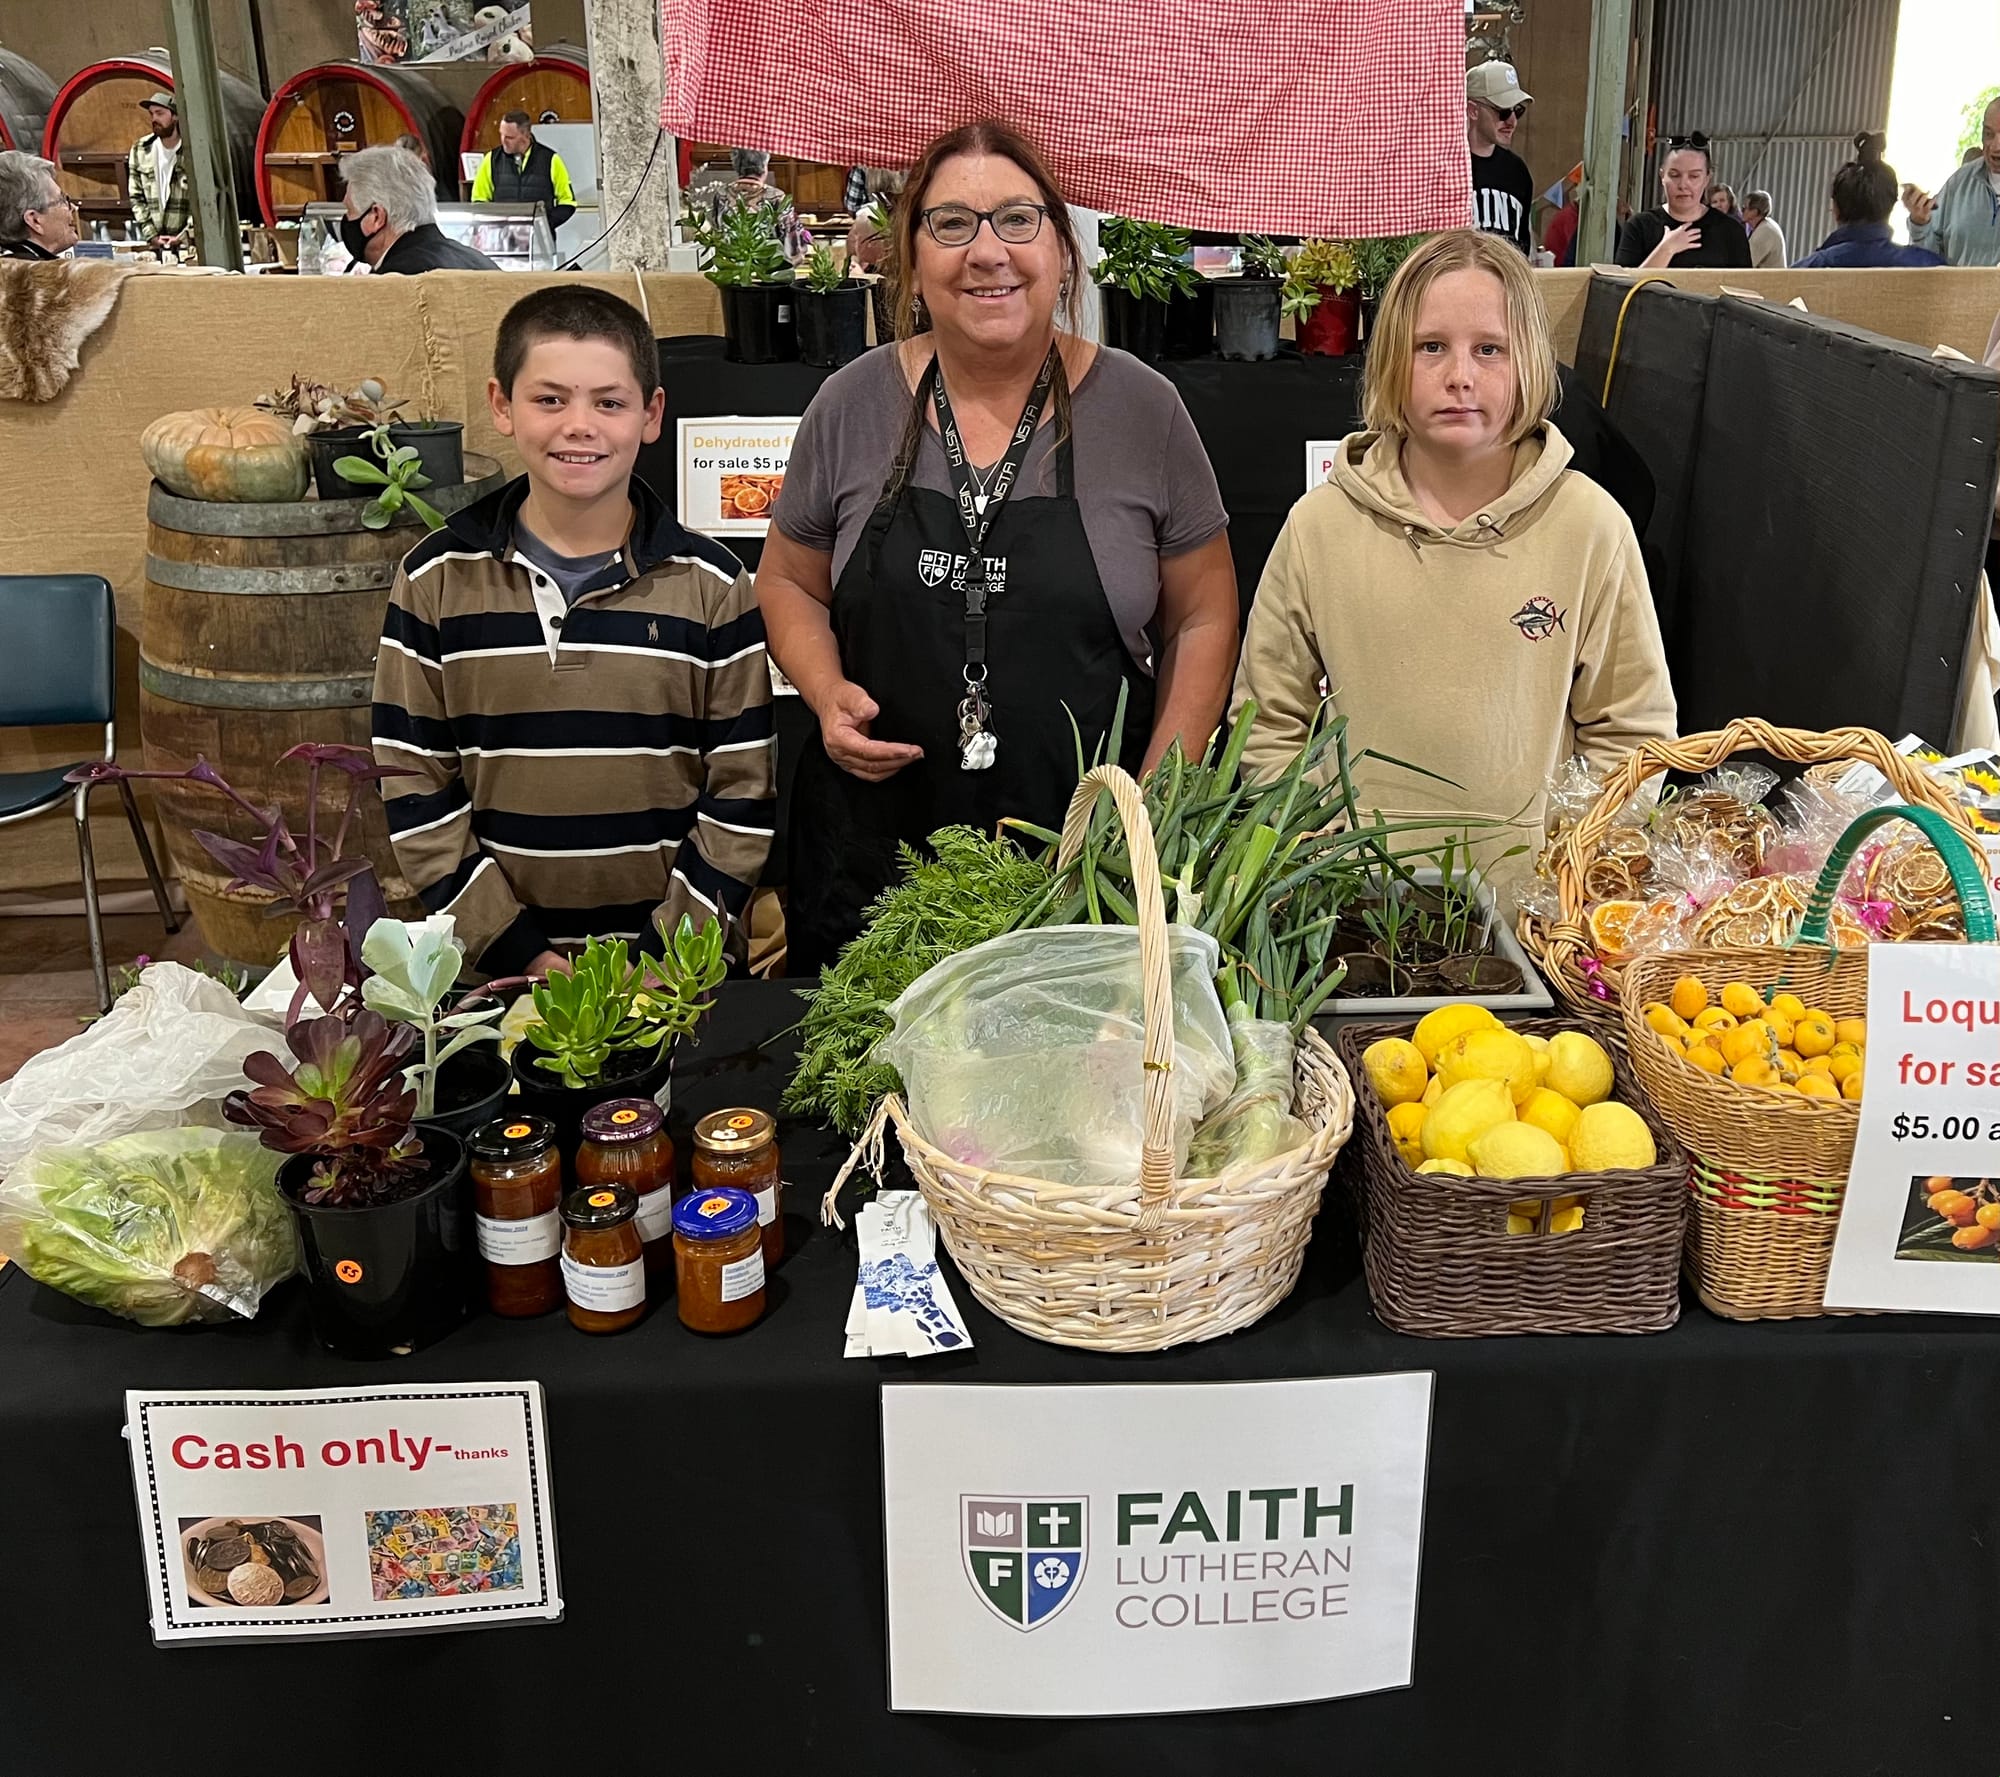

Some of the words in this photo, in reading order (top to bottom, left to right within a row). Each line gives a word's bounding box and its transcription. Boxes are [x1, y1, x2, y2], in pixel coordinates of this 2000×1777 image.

[693, 436, 781, 449] Dehydrated
[944, 420, 963, 468] VISTA
[1011, 404, 1039, 447] VISTA
[693, 457, 714, 469] for
[718, 457, 750, 469] sale
[753, 456, 771, 470] $5
[988, 461, 1017, 505] VISTA
[958, 481, 977, 529] VISTA
[1898, 1053, 1955, 1085] for
[1891, 1112, 1980, 1142] $5.00
[172, 1435, 305, 1470] Cash
[454, 1447, 509, 1460] thanks
[1117, 1484, 1354, 1546] FAITH
[1117, 1546, 1352, 1585] LUTHERAN
[1115, 1584, 1350, 1629] COLLEGE
